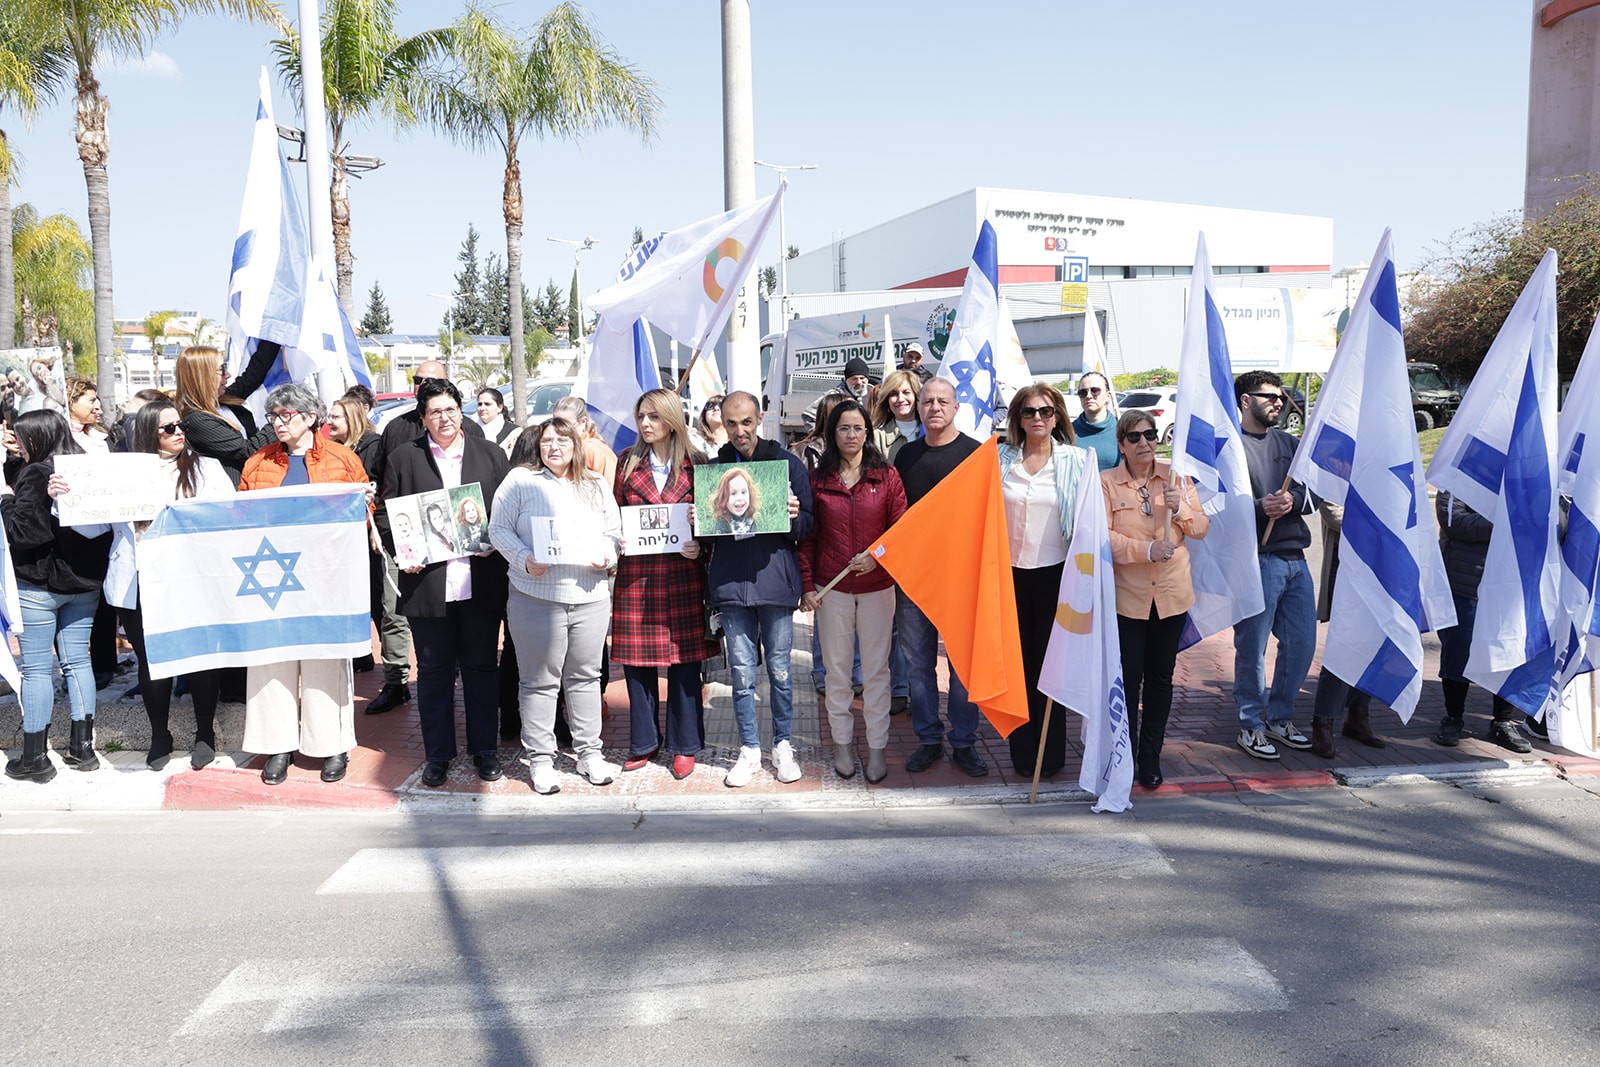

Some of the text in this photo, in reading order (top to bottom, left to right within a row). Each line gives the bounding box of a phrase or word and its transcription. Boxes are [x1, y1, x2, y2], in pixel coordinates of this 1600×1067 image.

[1070, 264, 1082, 281] P
[1223, 306, 1280, 321] חניון מגדל
[822, 348, 838, 364] פני
[894, 342, 911, 359] אג
[795, 351, 820, 368] העיר
[638, 532, 679, 546] סליחה
